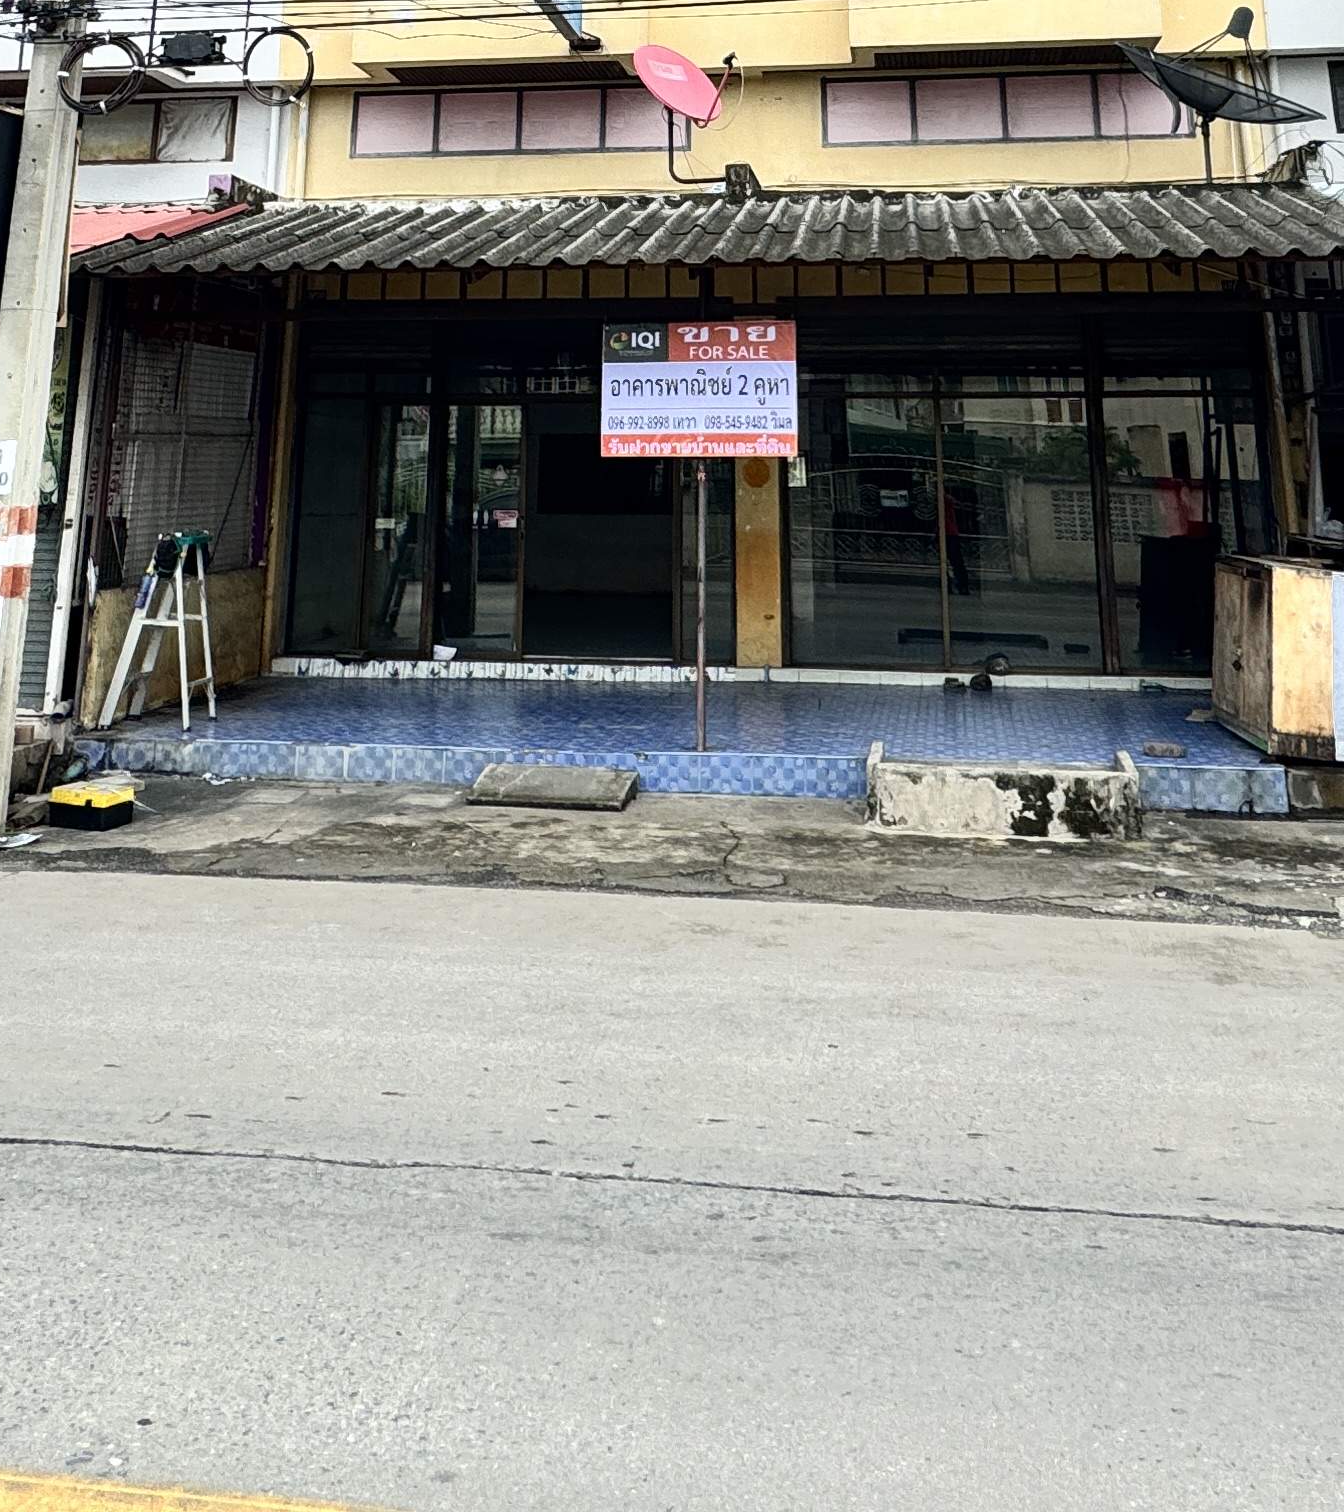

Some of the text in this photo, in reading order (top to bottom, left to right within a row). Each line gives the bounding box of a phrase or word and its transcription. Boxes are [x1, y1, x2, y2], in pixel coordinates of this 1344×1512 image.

[631, 332, 660, 348] IQI
[677, 325, 776, 343] ขาย
[690, 346, 768, 359] FOR SALE
[611, 366, 789, 405] อาคารพาณิชย์ 2 คูหา
